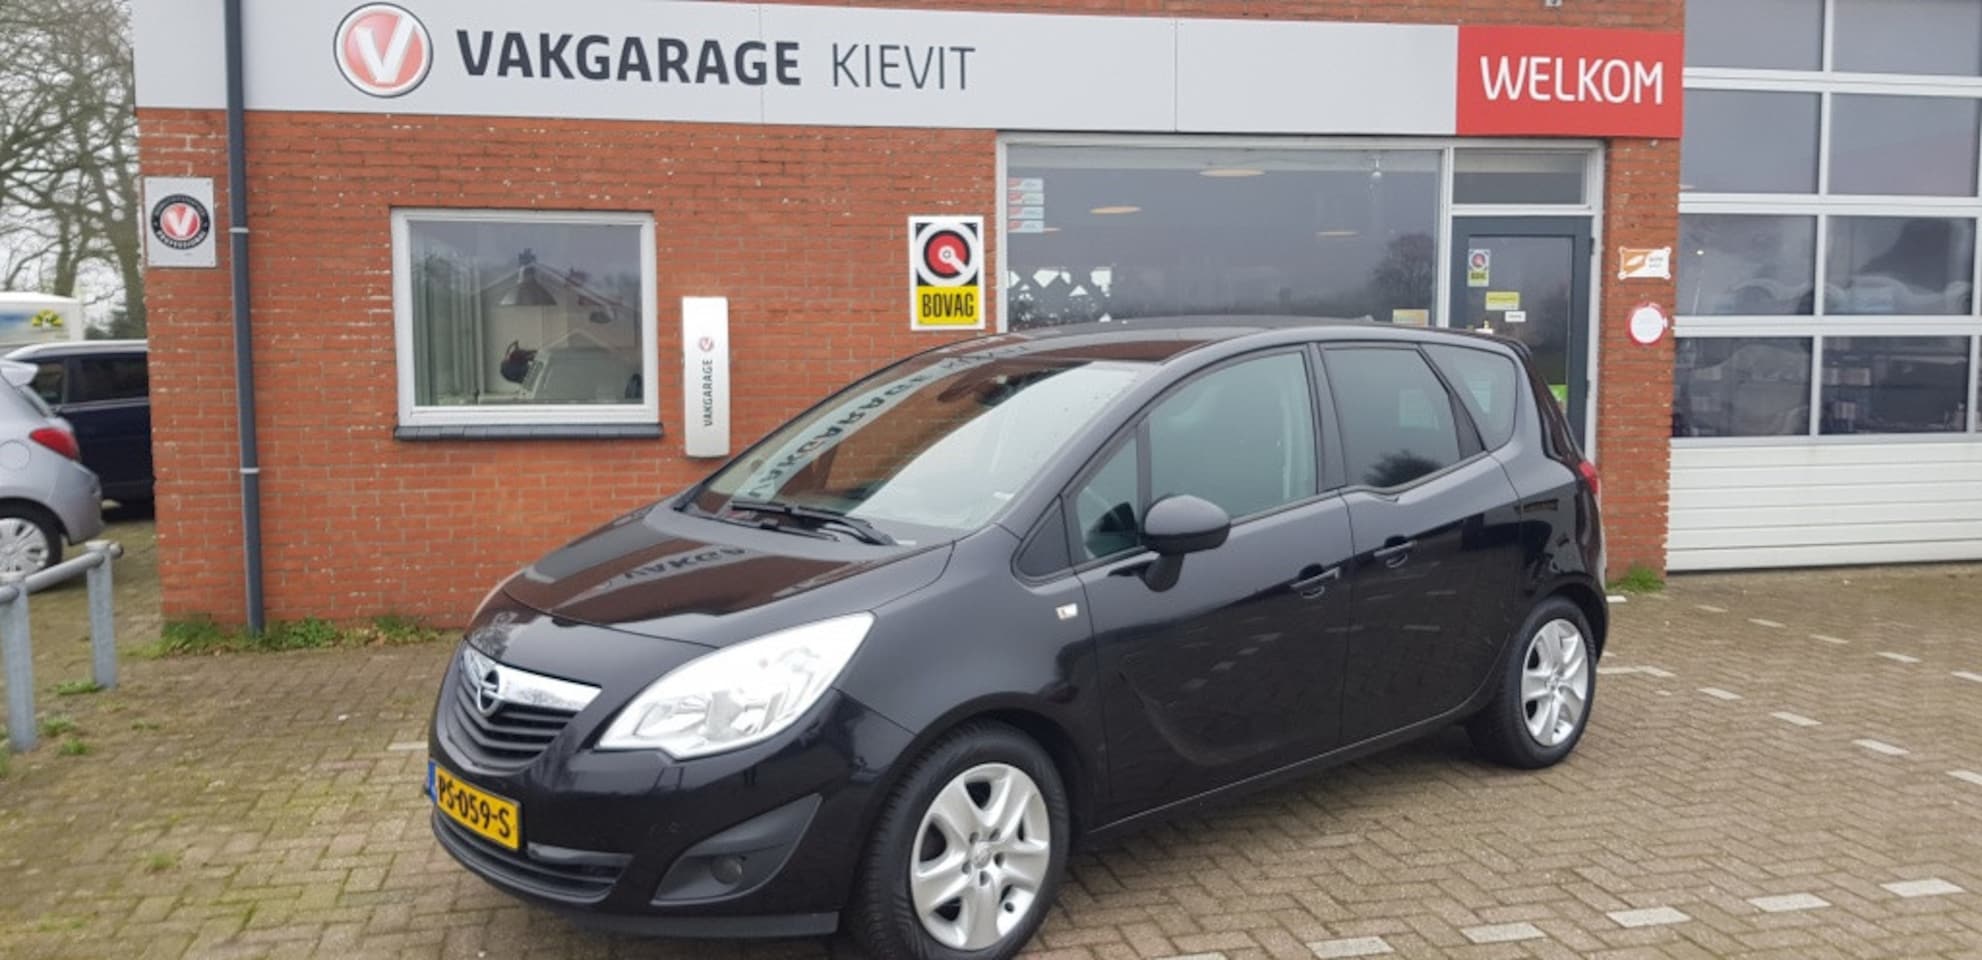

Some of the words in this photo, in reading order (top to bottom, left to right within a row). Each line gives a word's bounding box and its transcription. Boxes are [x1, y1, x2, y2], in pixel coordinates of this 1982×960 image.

[456, 29, 801, 85] VAKGARAGE
[832, 43, 976, 90] KIEVIT
[1480, 56, 1663, 104] WELKOM
[922, 292, 974, 318] BOVAG
[702, 359, 713, 427] VAKGARAGE
[438, 775, 511, 839] PS-059-S
